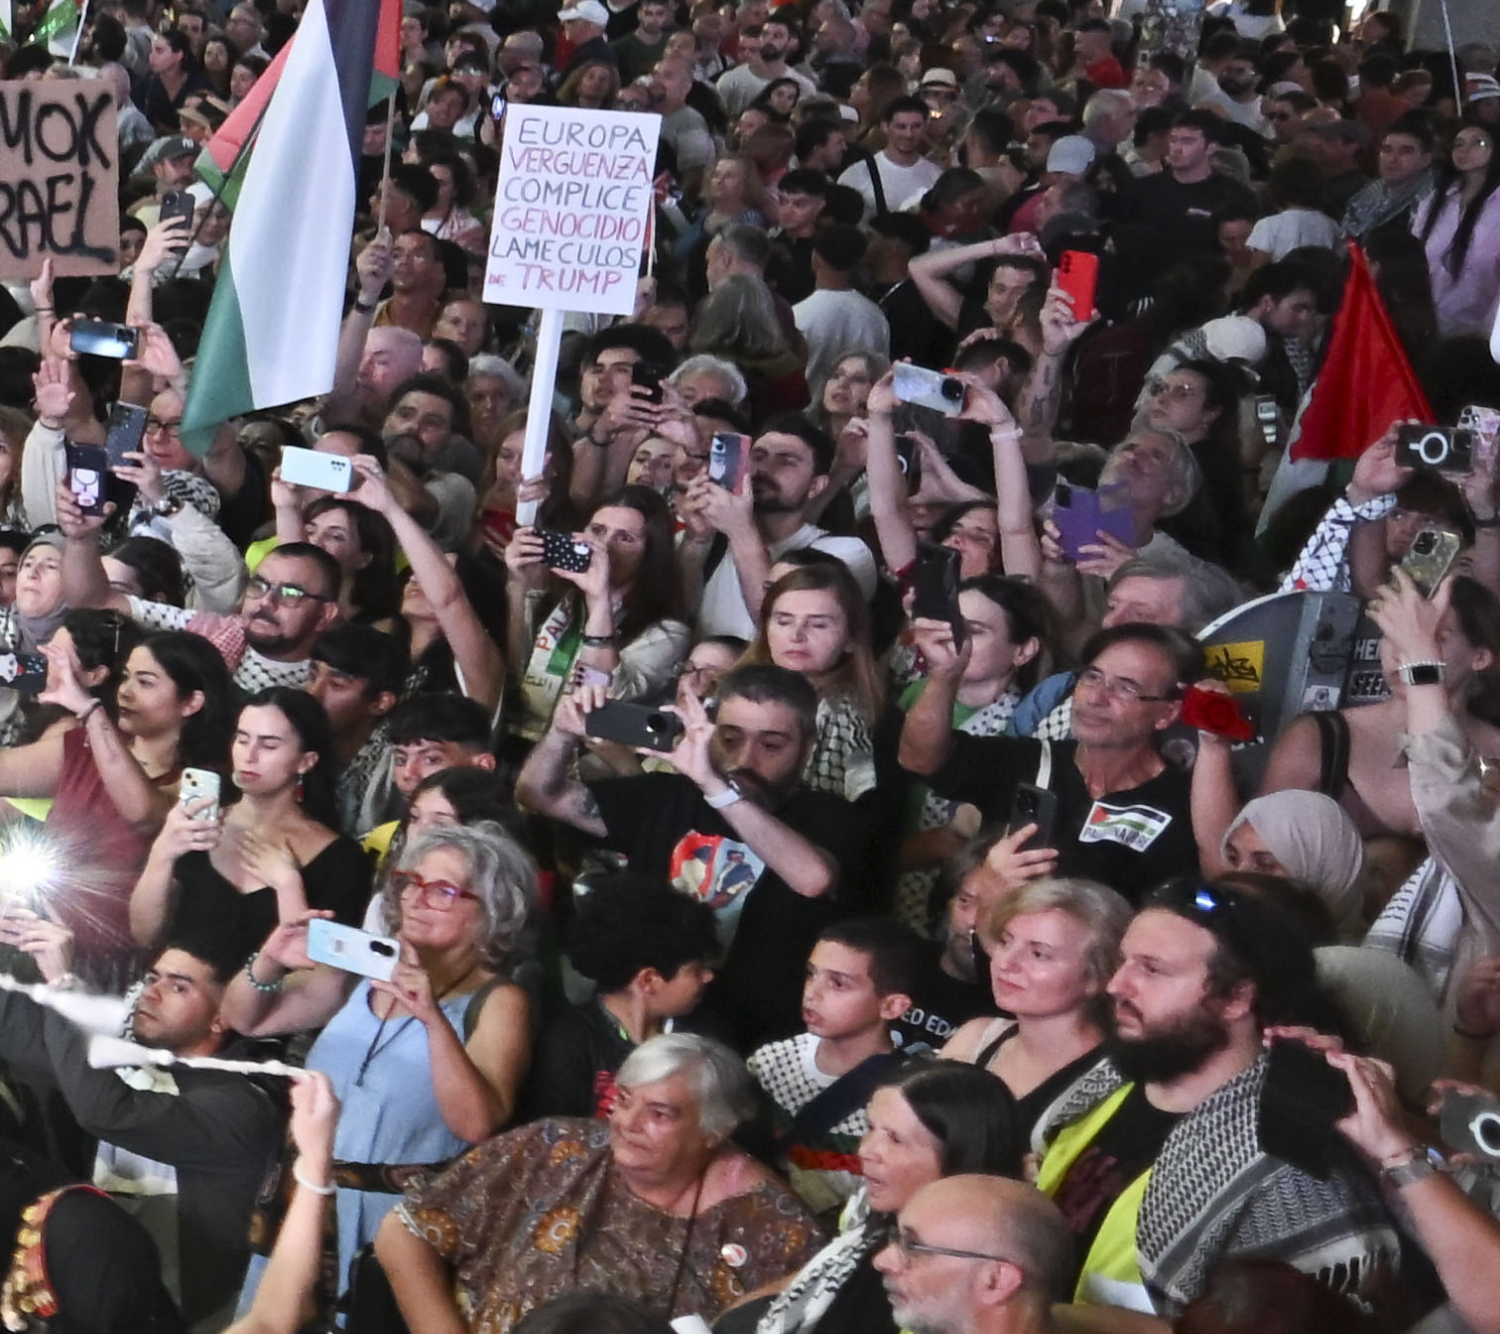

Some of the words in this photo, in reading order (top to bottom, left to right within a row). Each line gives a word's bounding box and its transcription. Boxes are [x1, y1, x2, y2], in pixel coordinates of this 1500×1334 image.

[508, 145, 652, 185] VERGUENZA
[504, 177, 643, 213] COMPLICE
[500, 206, 642, 243] GENOCIDIO
[515, 263, 623, 295] TRUMP
